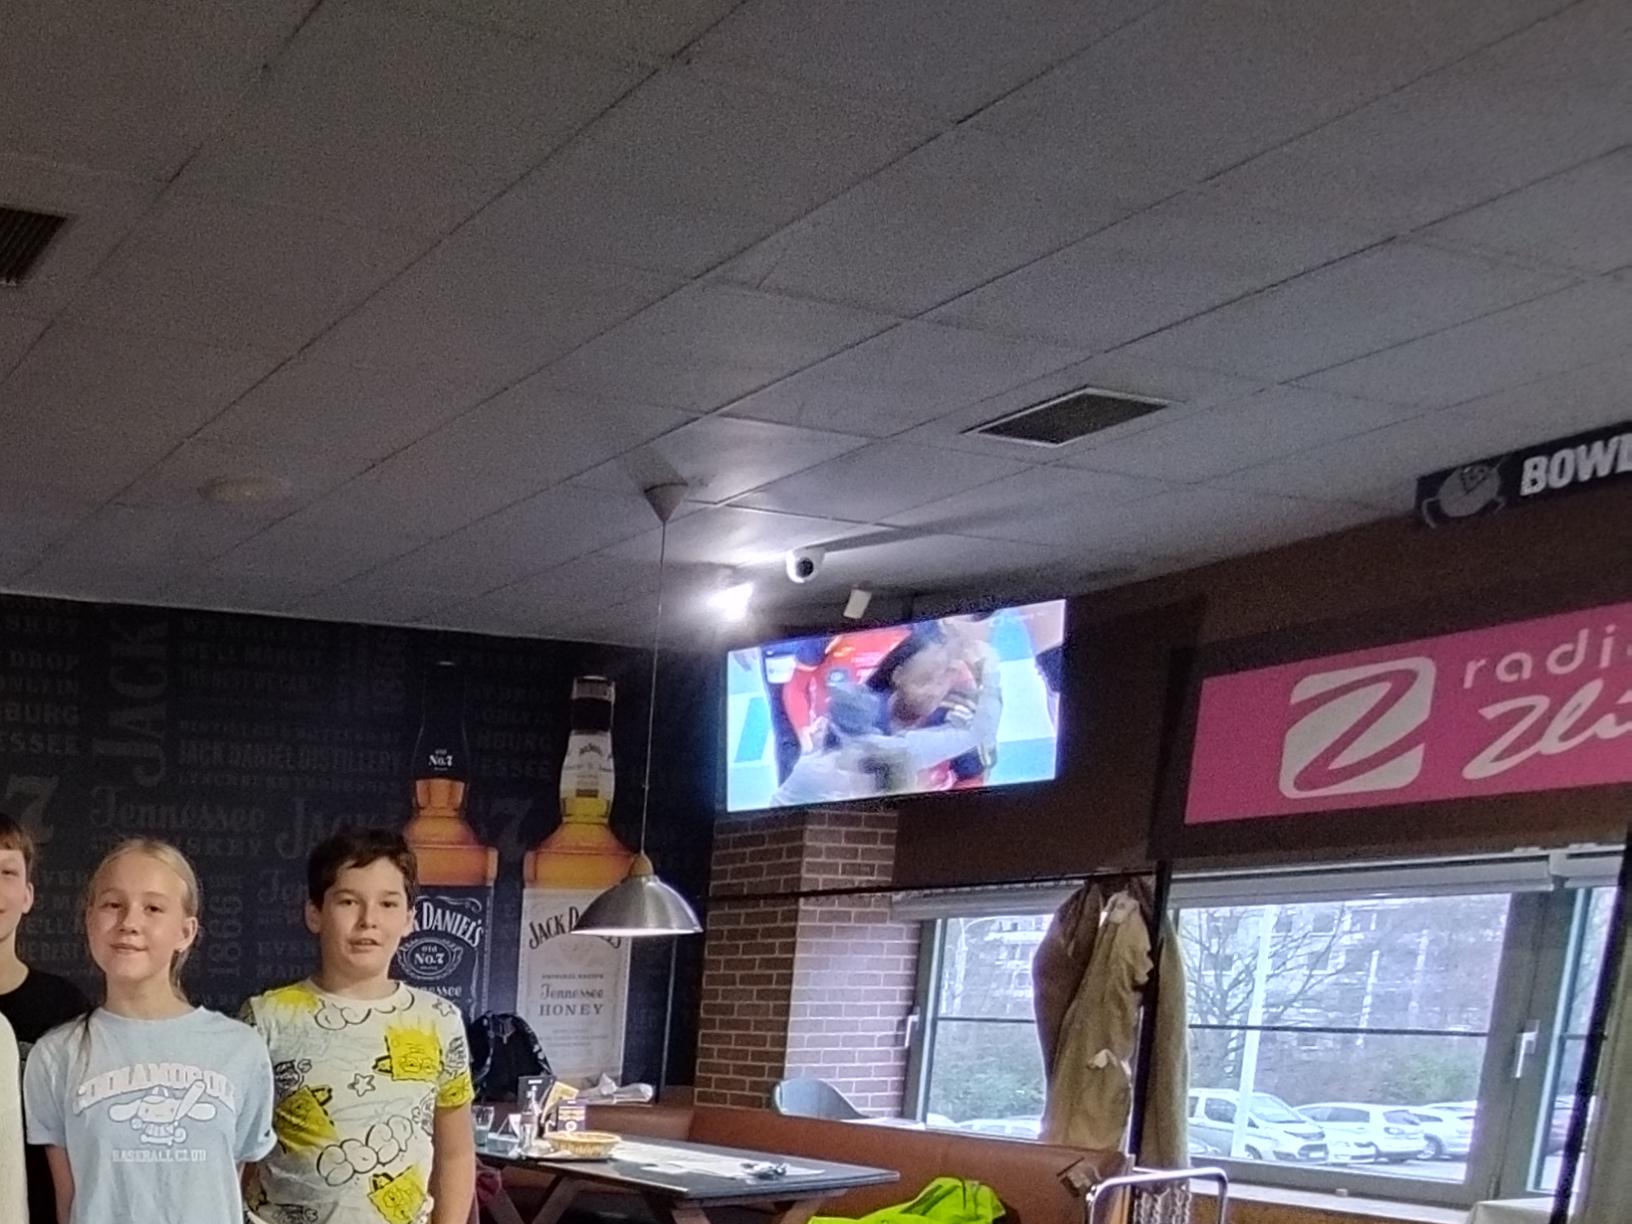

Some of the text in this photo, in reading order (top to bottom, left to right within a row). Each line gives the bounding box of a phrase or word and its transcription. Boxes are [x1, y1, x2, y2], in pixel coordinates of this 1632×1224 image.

[1464, 624, 1632, 689] radi
[538, 1003, 604, 1016] HONEY
[112, 1149, 173, 1163] BASEBALL
